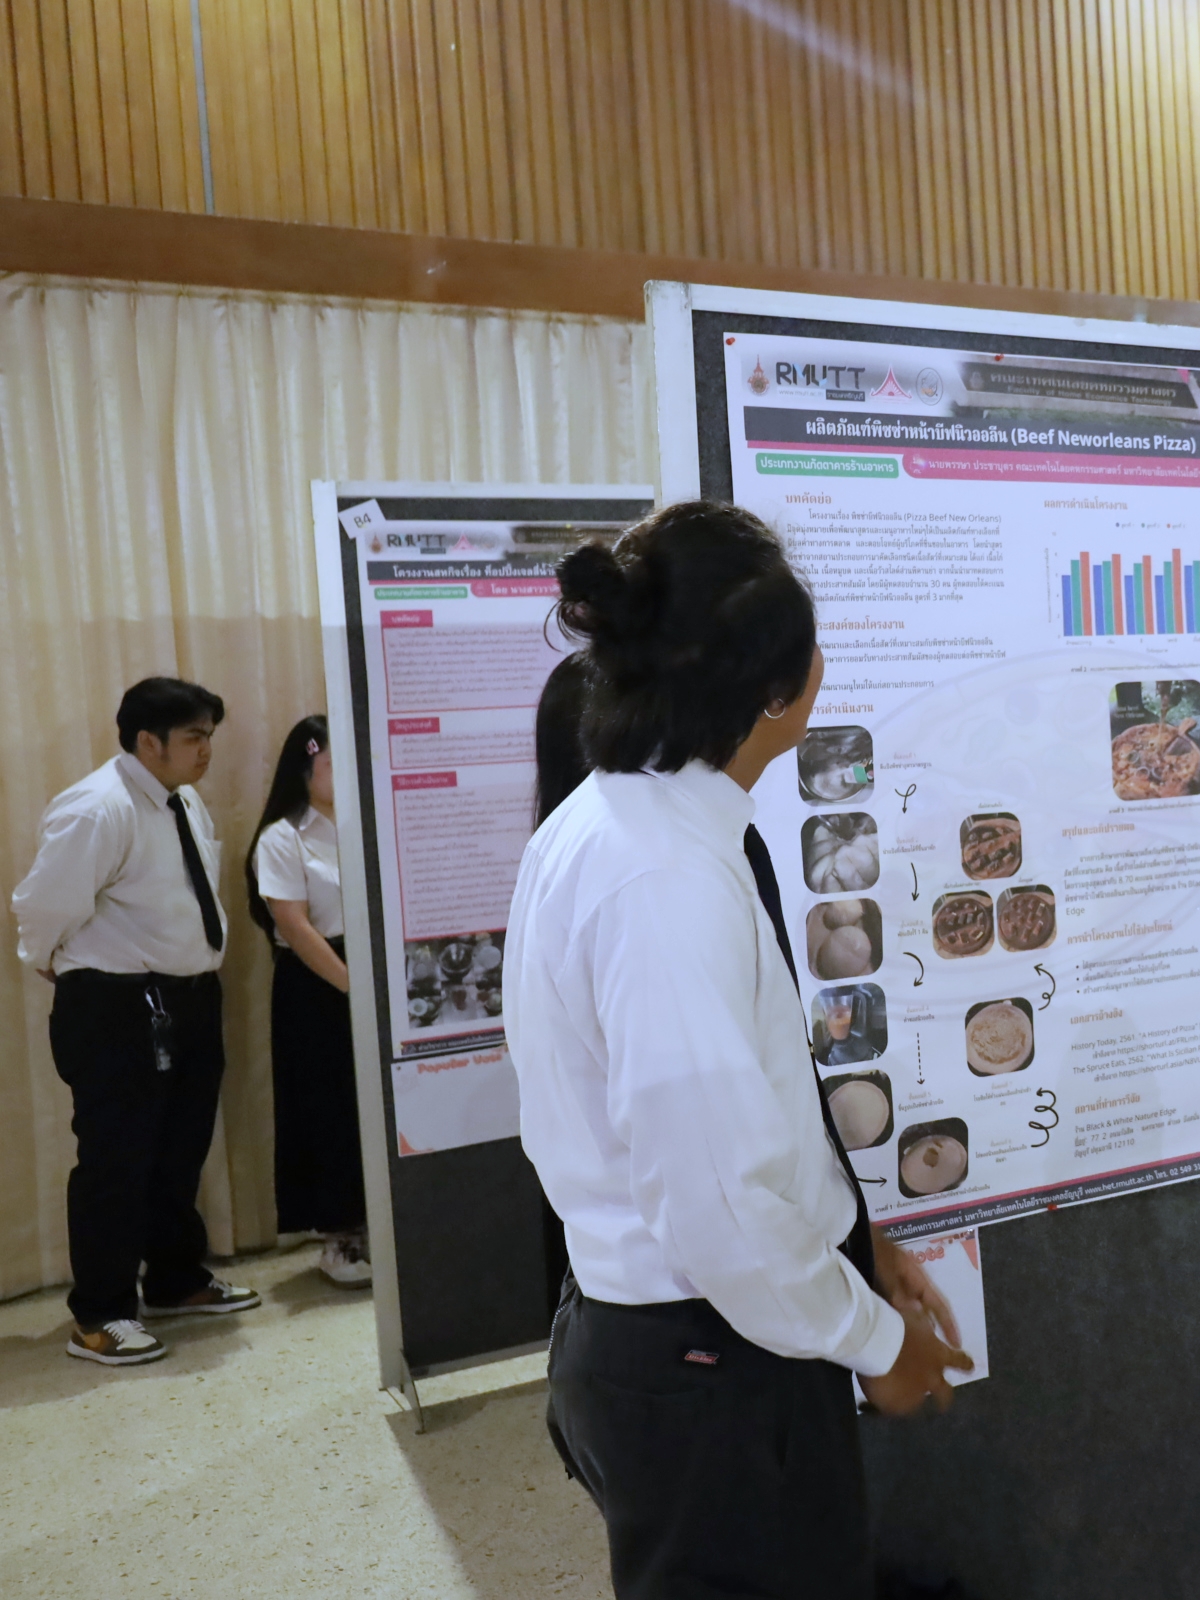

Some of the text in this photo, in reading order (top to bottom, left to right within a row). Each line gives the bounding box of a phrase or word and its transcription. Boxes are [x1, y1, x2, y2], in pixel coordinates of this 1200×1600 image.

[776, 361, 865, 390] RMUTT
[806, 417, 1196, 455] ผลิตภัณฑ์พิซซ่าหน้าบีฟนิวออลีน (Beef Neworleans Pizza)
[785, 492, 832, 505] บทคัดย่อ
[904, 512, 927, 522] (Pizza
[929, 513, 947, 522] Beef
[949, 514, 966, 522] New
[968, 513, 1002, 524] Orleans)
[930, 580, 941, 589] 30
[1066, 907, 1085, 917] Edge
[1071, 1040, 1096, 1051] History
[1147, 1028, 1171, 1039] History
[1072, 1066, 1086, 1075] The
[1086, 1061, 1110, 1074] Spruce
[1086, 1121, 1105, 1132] Black
[1106, 1119, 1112, 1127] &
[1112, 1115, 1134, 1127] White
[1134, 1111, 1158, 1123] Nature
[1159, 1107, 1177, 1119] Edge
[885, 1210, 963, 1239] คโนโลยีคหกรรมศาสตร์
